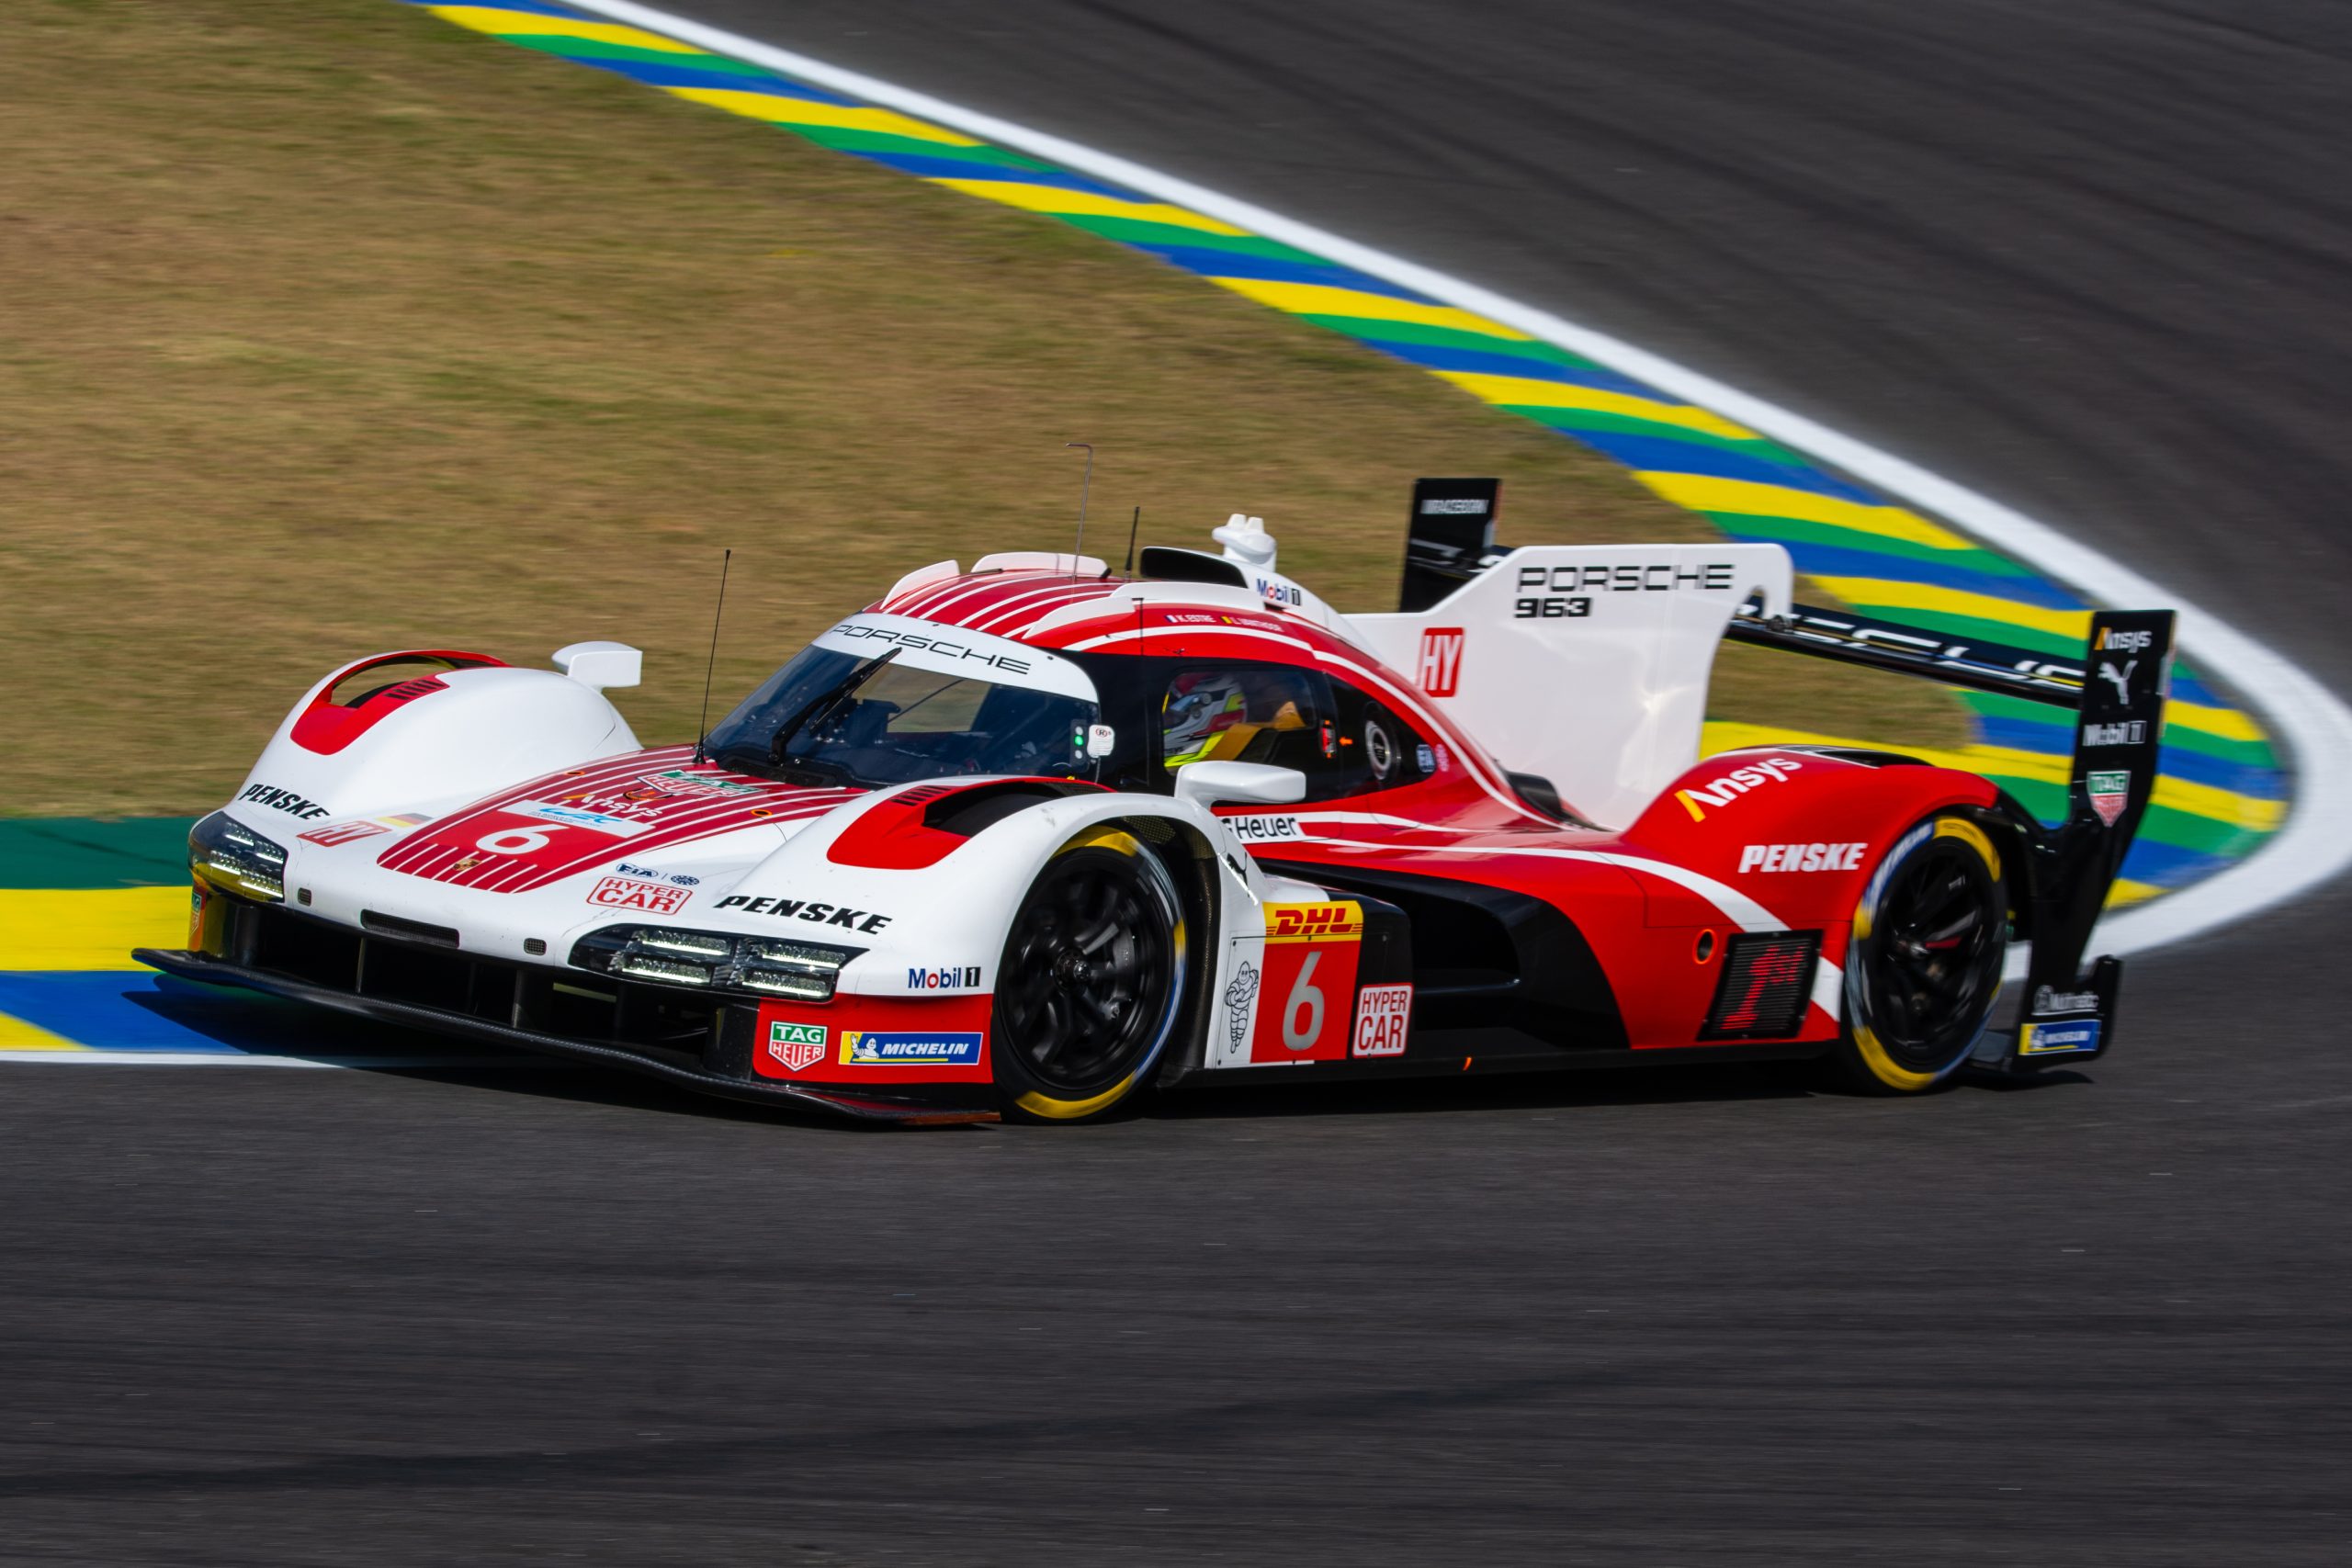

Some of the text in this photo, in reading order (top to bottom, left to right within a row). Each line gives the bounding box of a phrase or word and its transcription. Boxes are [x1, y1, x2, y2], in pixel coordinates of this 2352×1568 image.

[1257, 579, 1289, 603] Mobil
[1516, 563, 1734, 593] PORSCHE
[1514, 596, 1592, 618] 963
[830, 625, 1031, 675] PORSCHE
[2094, 627, 2153, 654] Ansys
[1419, 634, 1464, 691] HY
[2082, 722, 2128, 746] Mobil
[238, 783, 332, 821] PENSKE
[1674, 757, 1804, 823] Ansys
[563, 792, 664, 818] Ansys
[475, 823, 571, 855] 6
[618, 863, 653, 878] FIA
[1736, 842, 1869, 874] PENSKE
[596, 888, 676, 912] CAR
[605, 878, 684, 899] HYPER
[714, 895, 894, 935] PENSKE
[1274, 908, 1353, 936] DHL
[908, 966, 980, 989] Mobil 1
[1282, 951, 1326, 1052] 6
[1361, 989, 1408, 1013] HYPER
[775, 1024, 824, 1043] TAG
[1358, 1014, 1406, 1051] CAR
[772, 1043, 823, 1069] HEUER
[881, 1042, 969, 1055] MICHELIN
